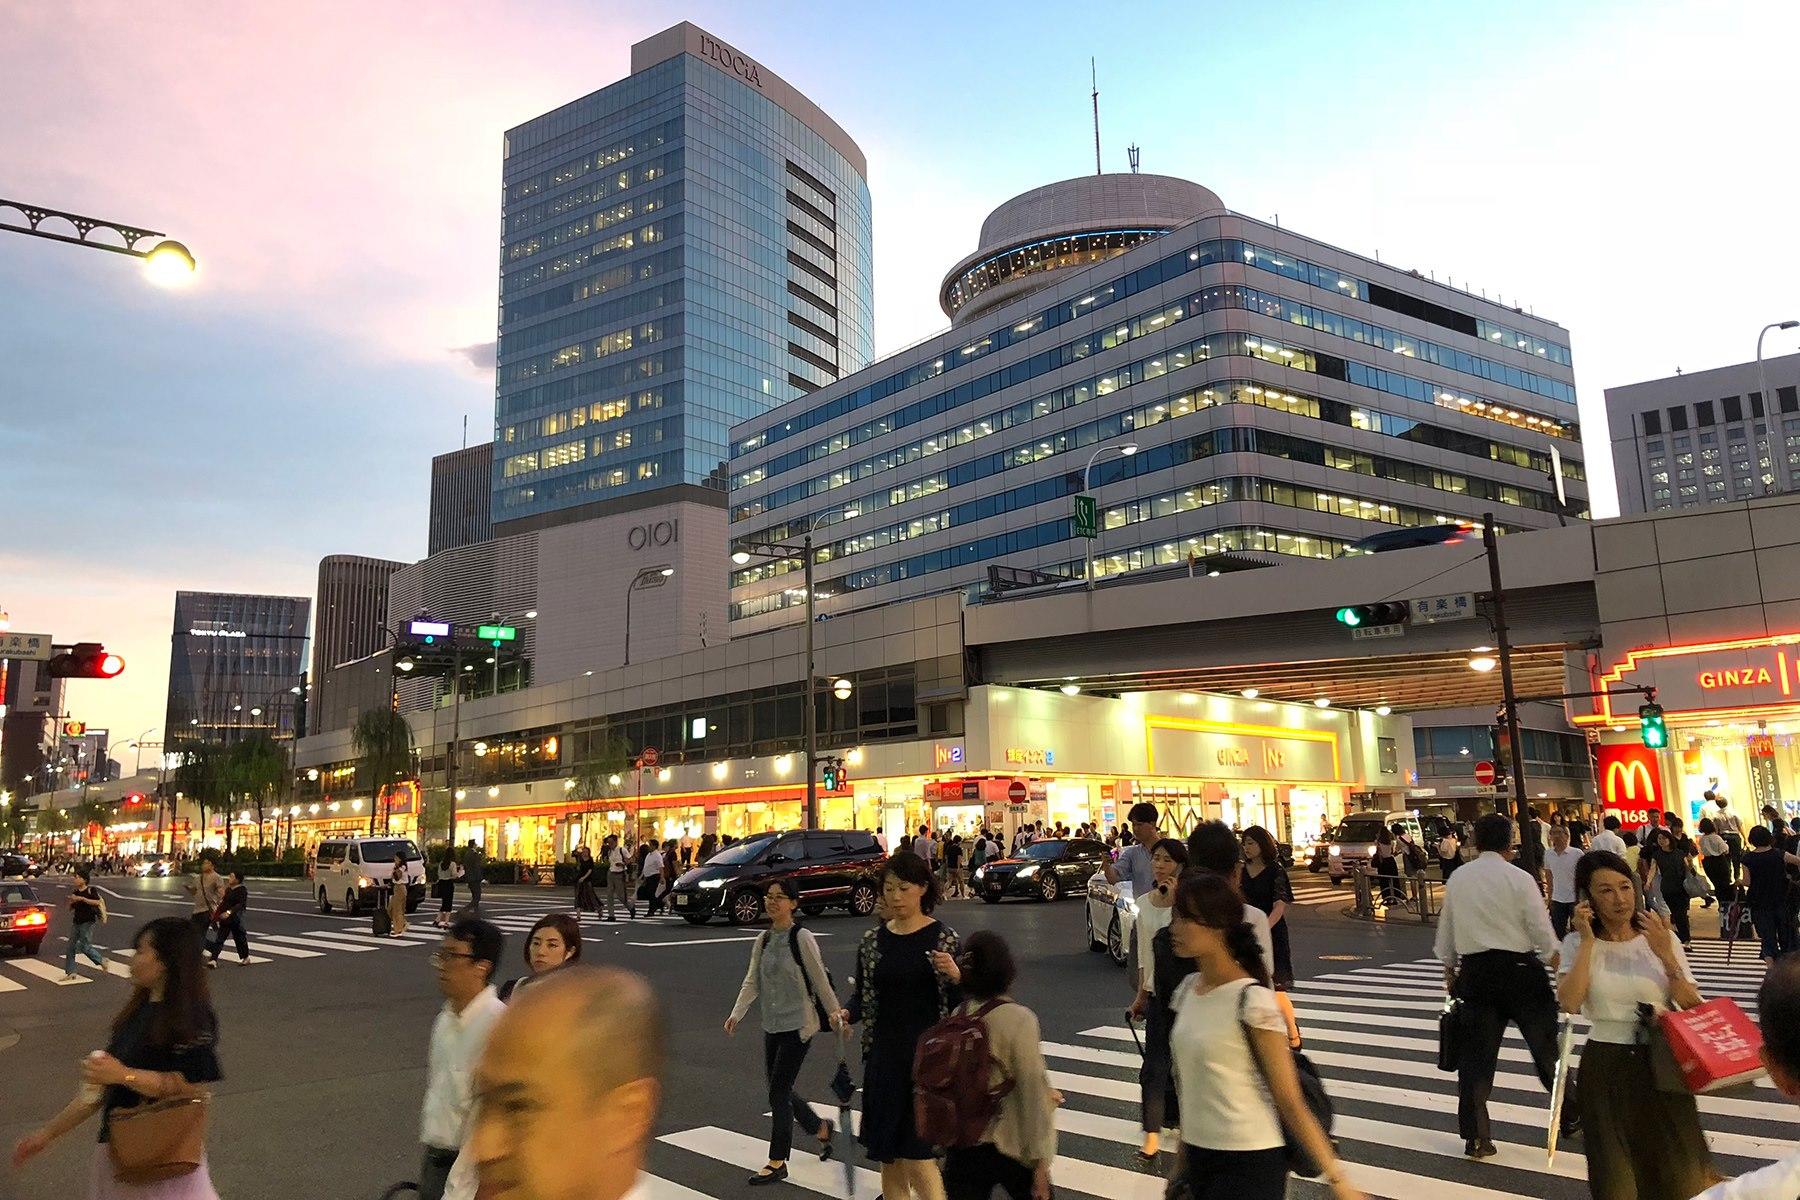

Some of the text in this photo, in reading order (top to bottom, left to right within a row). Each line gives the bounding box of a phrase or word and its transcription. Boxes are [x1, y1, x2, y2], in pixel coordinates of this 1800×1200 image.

[1417, 596, 1467, 613] 有楽橋
[1699, 667, 1772, 689] GINZA
